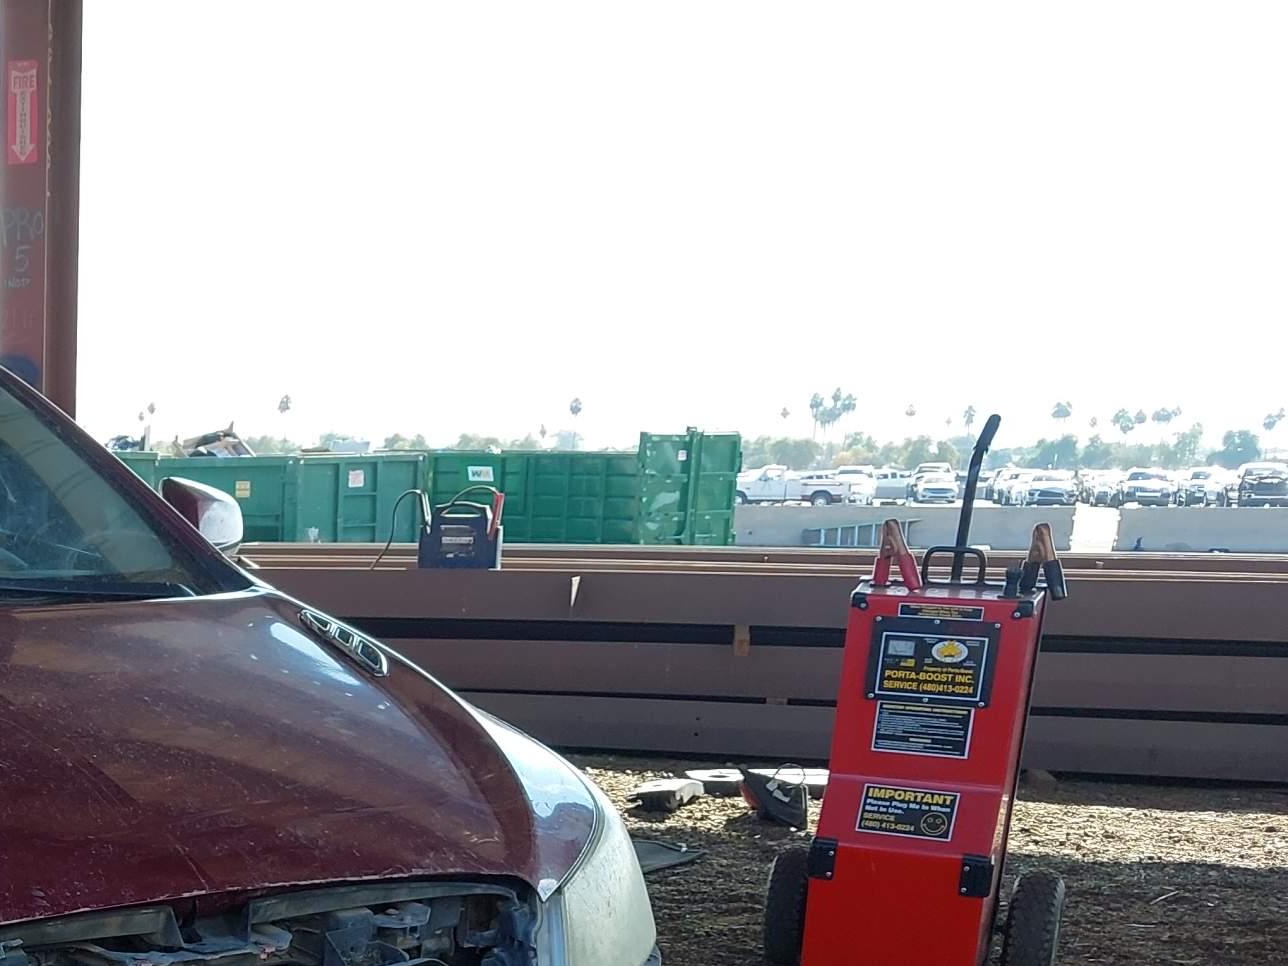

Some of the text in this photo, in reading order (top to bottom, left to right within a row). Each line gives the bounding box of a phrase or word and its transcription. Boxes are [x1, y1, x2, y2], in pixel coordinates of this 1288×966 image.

[13, 75, 35, 89] FIRE
[15, 245, 32, 272] 5
[884, 669, 975, 684] PORTA-BOOST INC.
[883, 680, 918, 690] SERVICE
[868, 787, 954, 805] IMPORTANT
[866, 798, 890, 806] Please
[892, 801, 907, 809] Plug
[909, 802, 920, 810] Me
[930, 805, 951, 813] When
[863, 812, 895, 821] SERVICE
